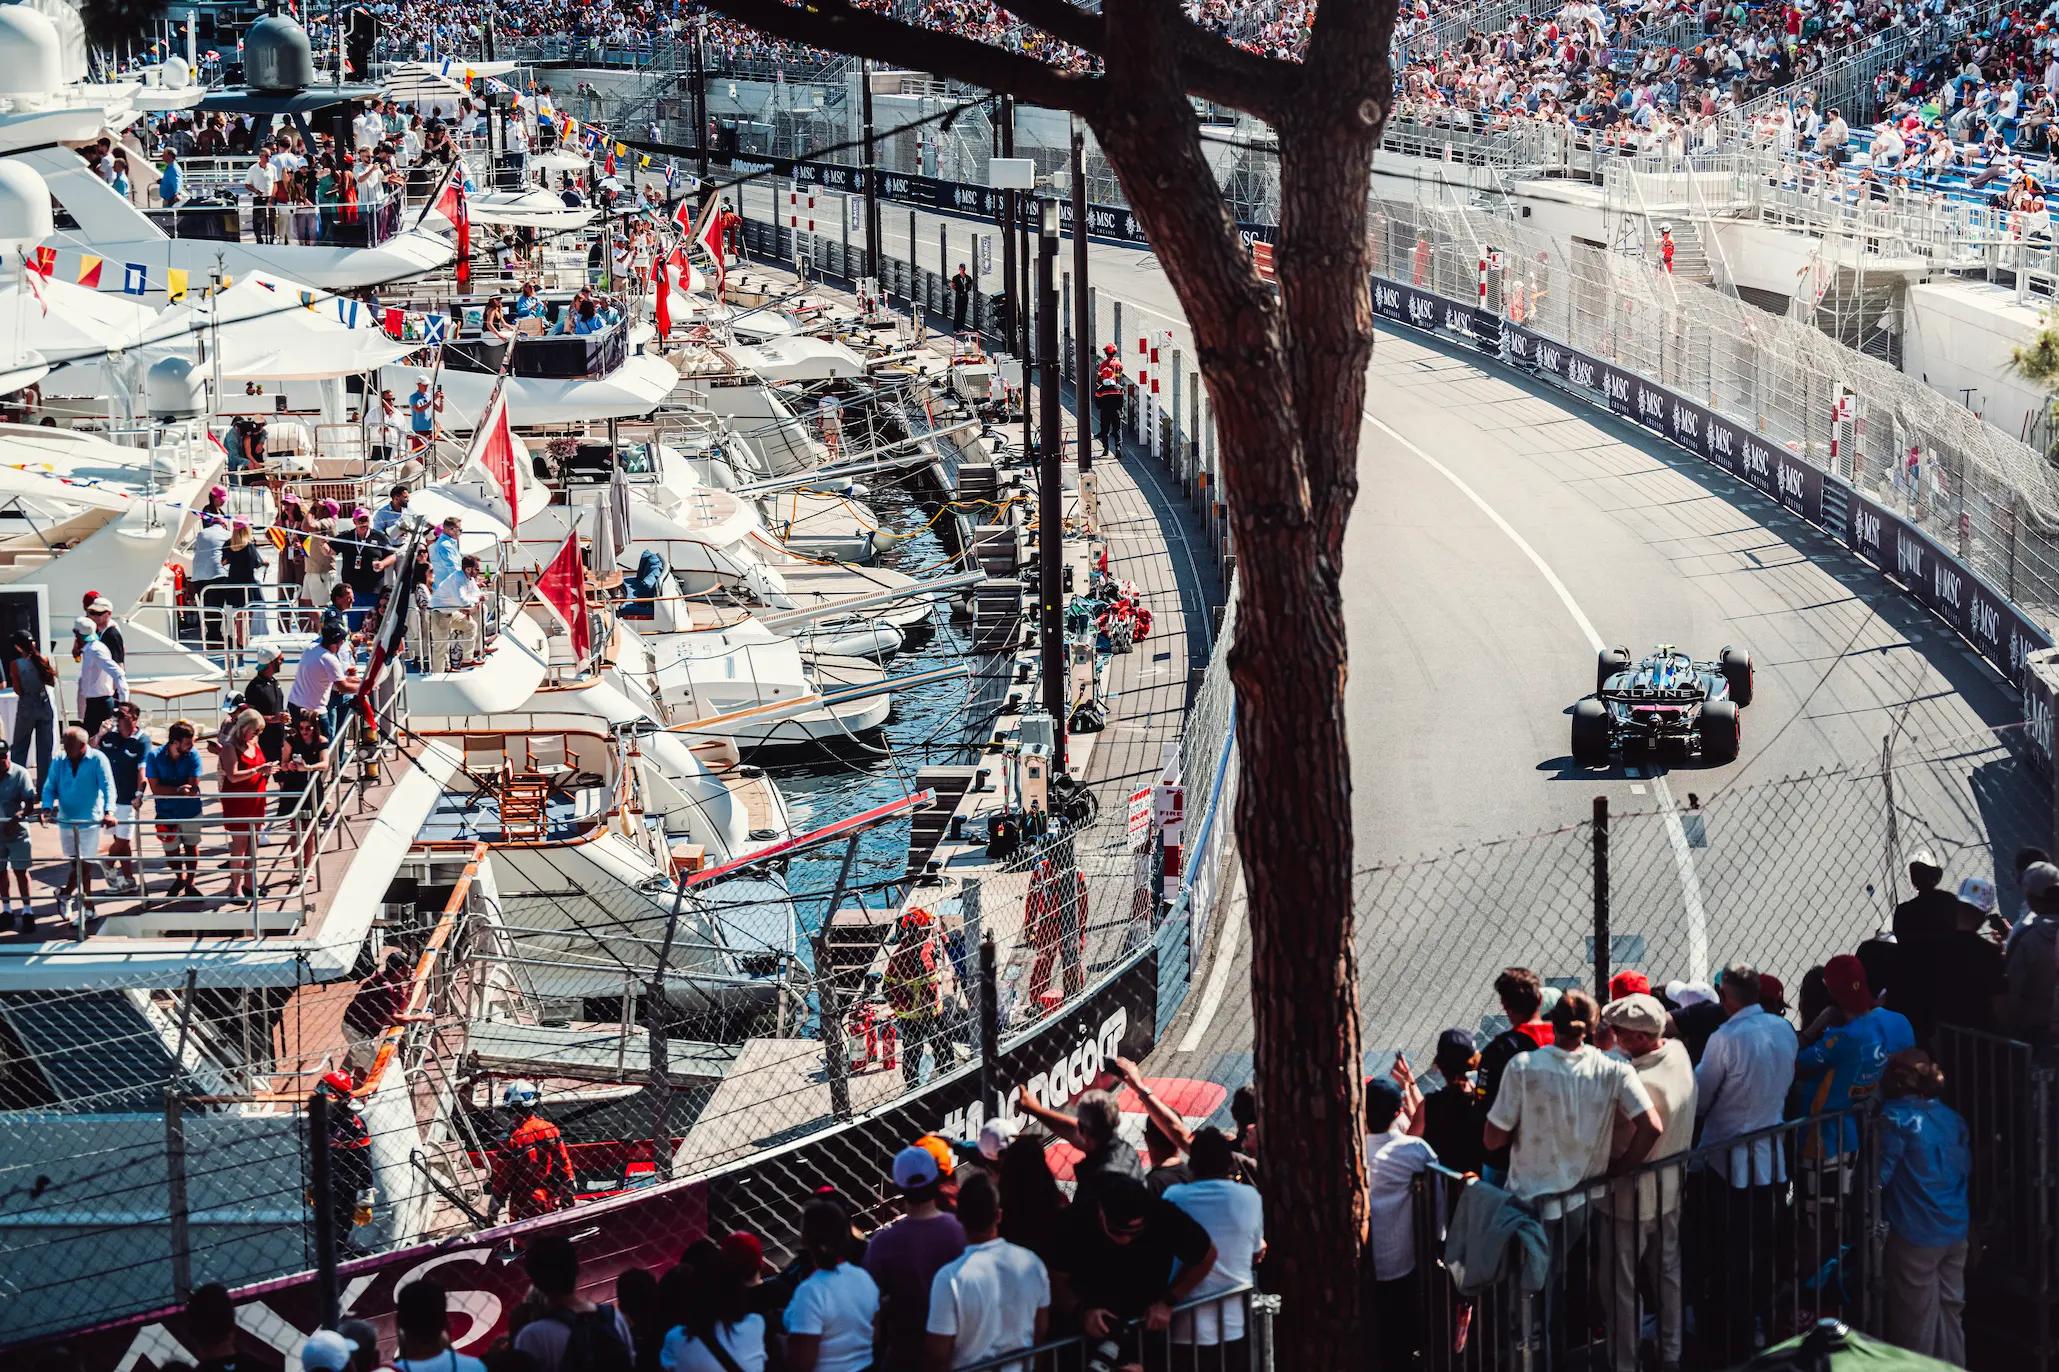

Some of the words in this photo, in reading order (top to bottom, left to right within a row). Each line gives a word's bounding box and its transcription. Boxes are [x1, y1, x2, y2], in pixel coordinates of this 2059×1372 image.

[800, 166, 816, 180] MSC
[831, 169, 846, 184] MSC
[892, 178, 909, 192] MSC
[961, 189, 977, 205] MSC
[1096, 211, 1115, 228] MSC
[1240, 230, 1259, 247] SC
[1383, 287, 1400, 309] MSC
[1416, 297, 1434, 320] MSC
[1453, 310, 1471, 330] MSC
[1511, 331, 1528, 356] MSC
[1543, 346, 1560, 372] MSC
[1576, 360, 1594, 386] MSC
[1611, 374, 1629, 402] MSC
[1646, 390, 1664, 419] MSC
[1680, 407, 1698, 437] MSC
[1715, 425, 1733, 456] MSC
[1751, 443, 1769, 477] MSC
[1785, 464, 1804, 499] MSC
[1942, 568, 1961, 609] MSC
[1980, 599, 2000, 646] MSC
